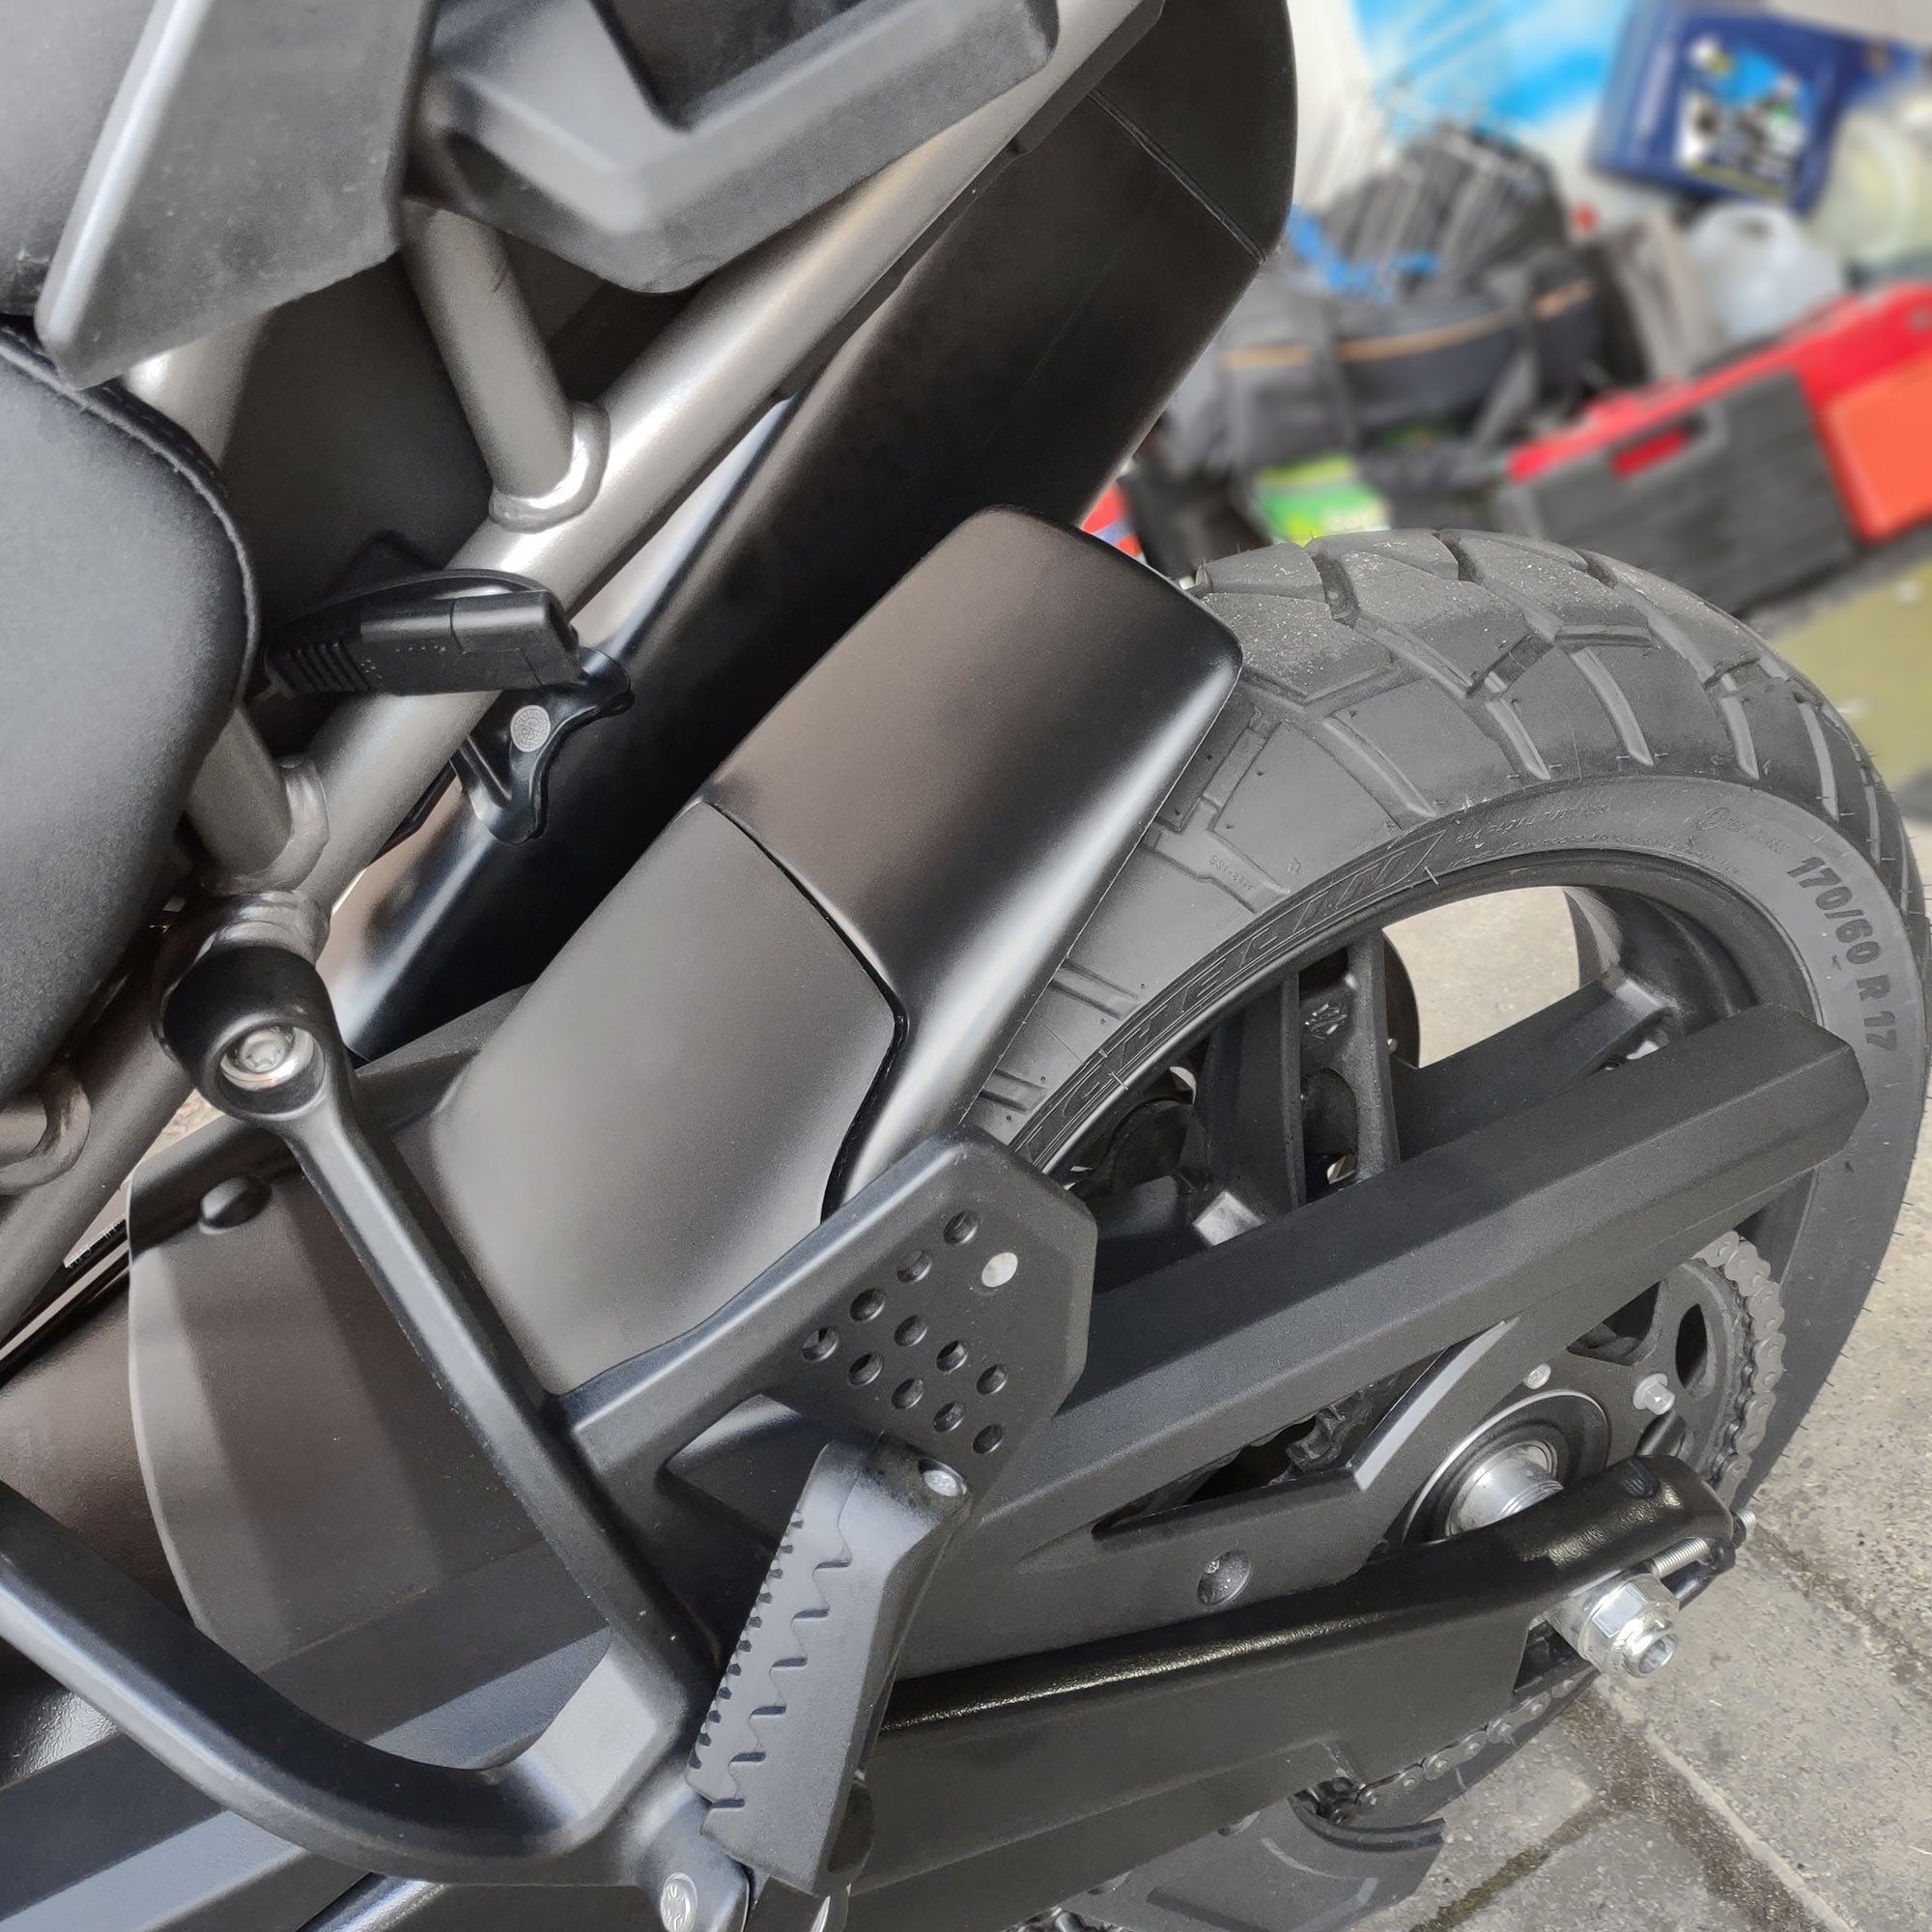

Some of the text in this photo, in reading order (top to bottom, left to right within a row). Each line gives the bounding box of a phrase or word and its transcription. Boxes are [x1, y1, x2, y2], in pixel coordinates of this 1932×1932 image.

[1026, 850, 1407, 1165] ICHELIN
[1786, 856, 1898, 1052] 170/60 R 17
